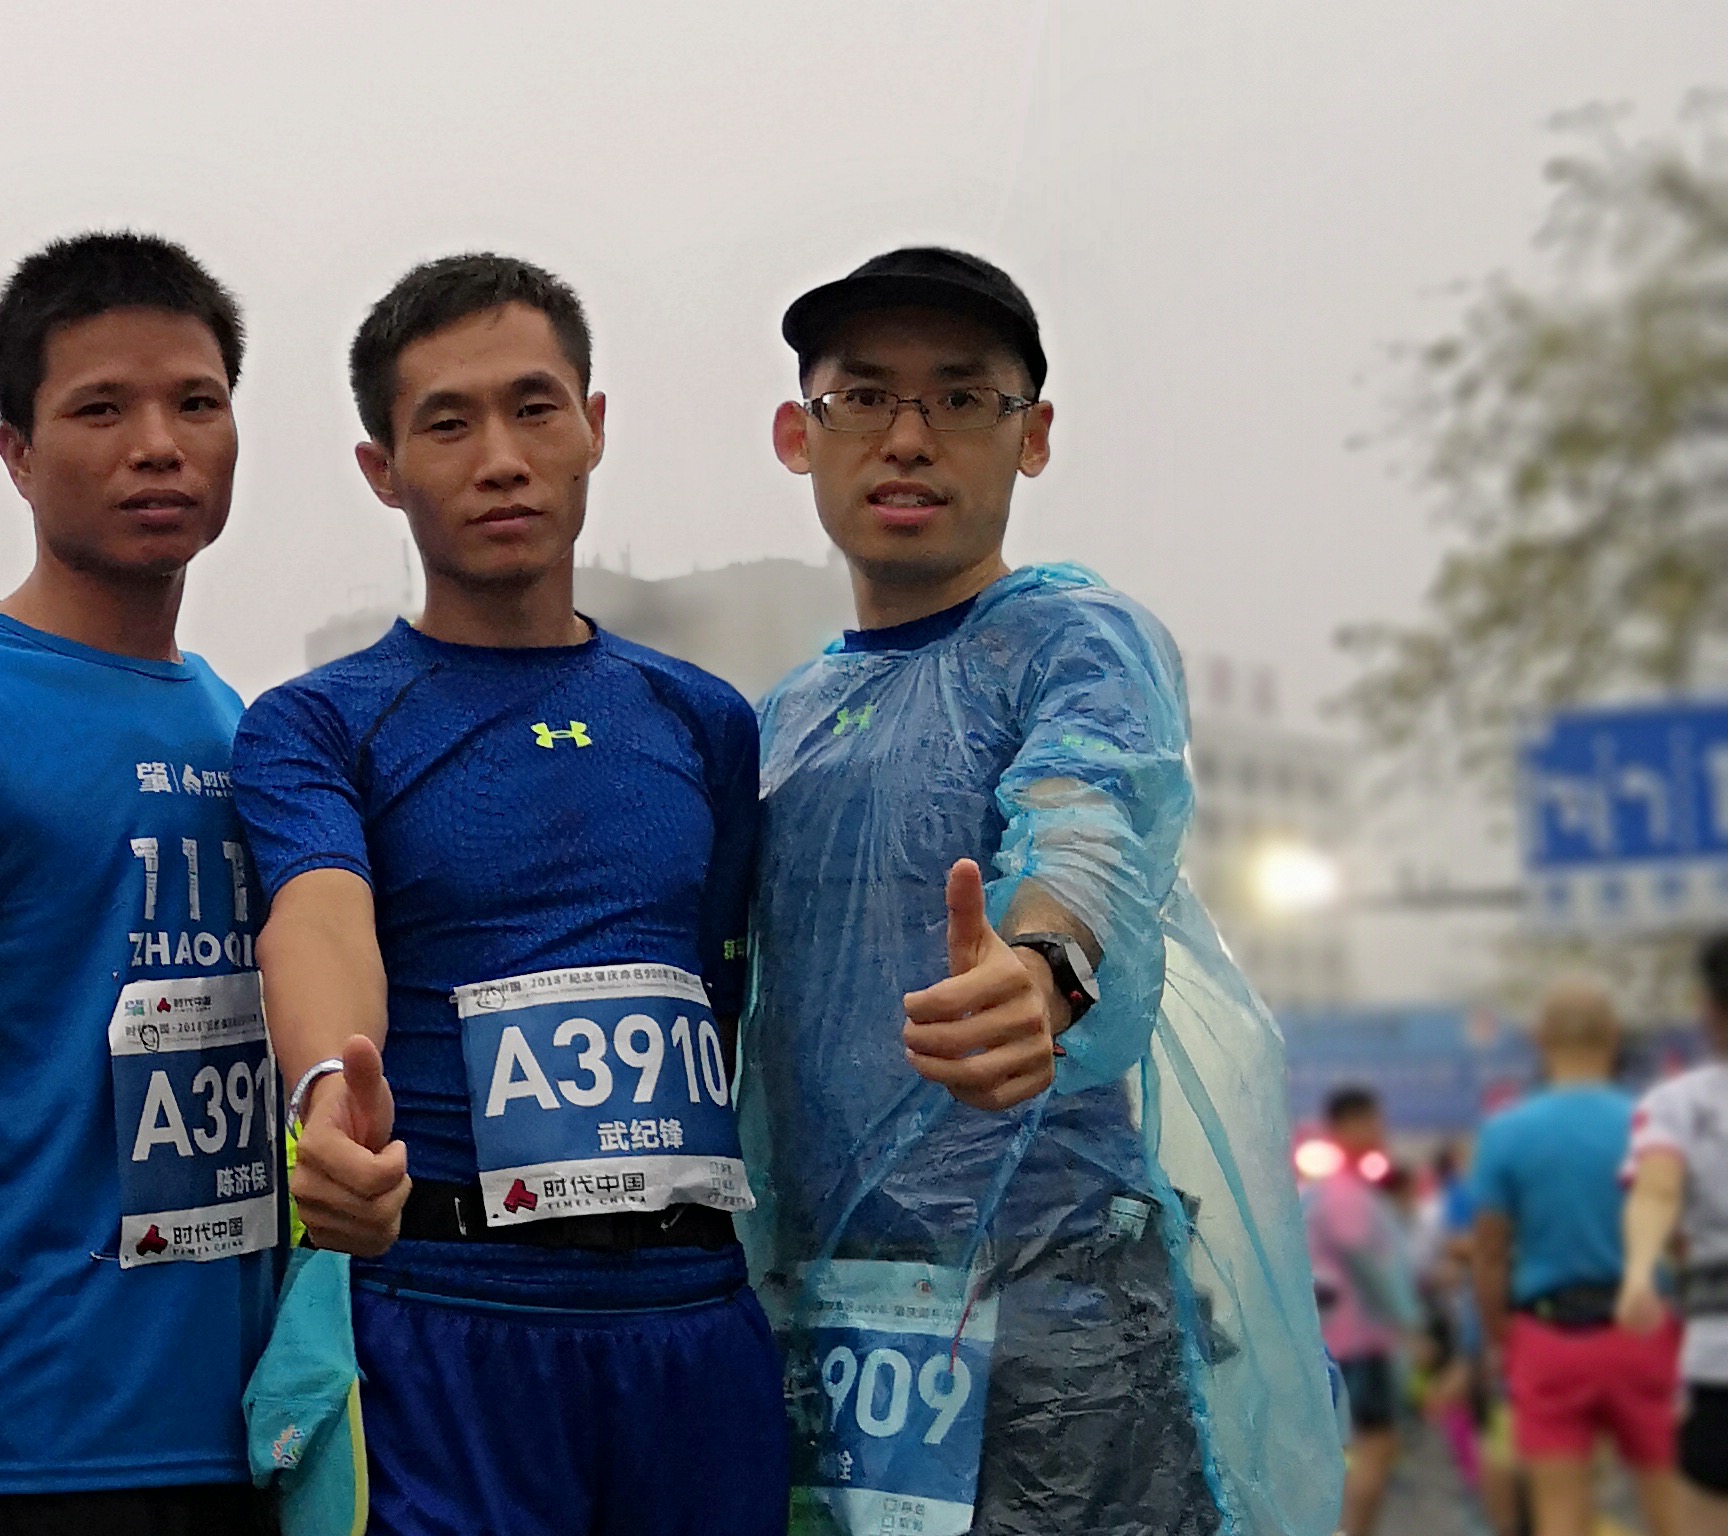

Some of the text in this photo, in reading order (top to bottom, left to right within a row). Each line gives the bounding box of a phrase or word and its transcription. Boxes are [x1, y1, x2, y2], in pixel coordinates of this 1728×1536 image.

[128, 931, 254, 968] ZHAOQI
[484, 1013, 728, 1118] A3910
[132, 1058, 275, 1161] A391
[597, 1118, 684, 1152] 武纪锋
[543, 1173, 646, 1198] 时代中国
[173, 1217, 243, 1245] 时代中国
[822, 1345, 971, 1444] 909
